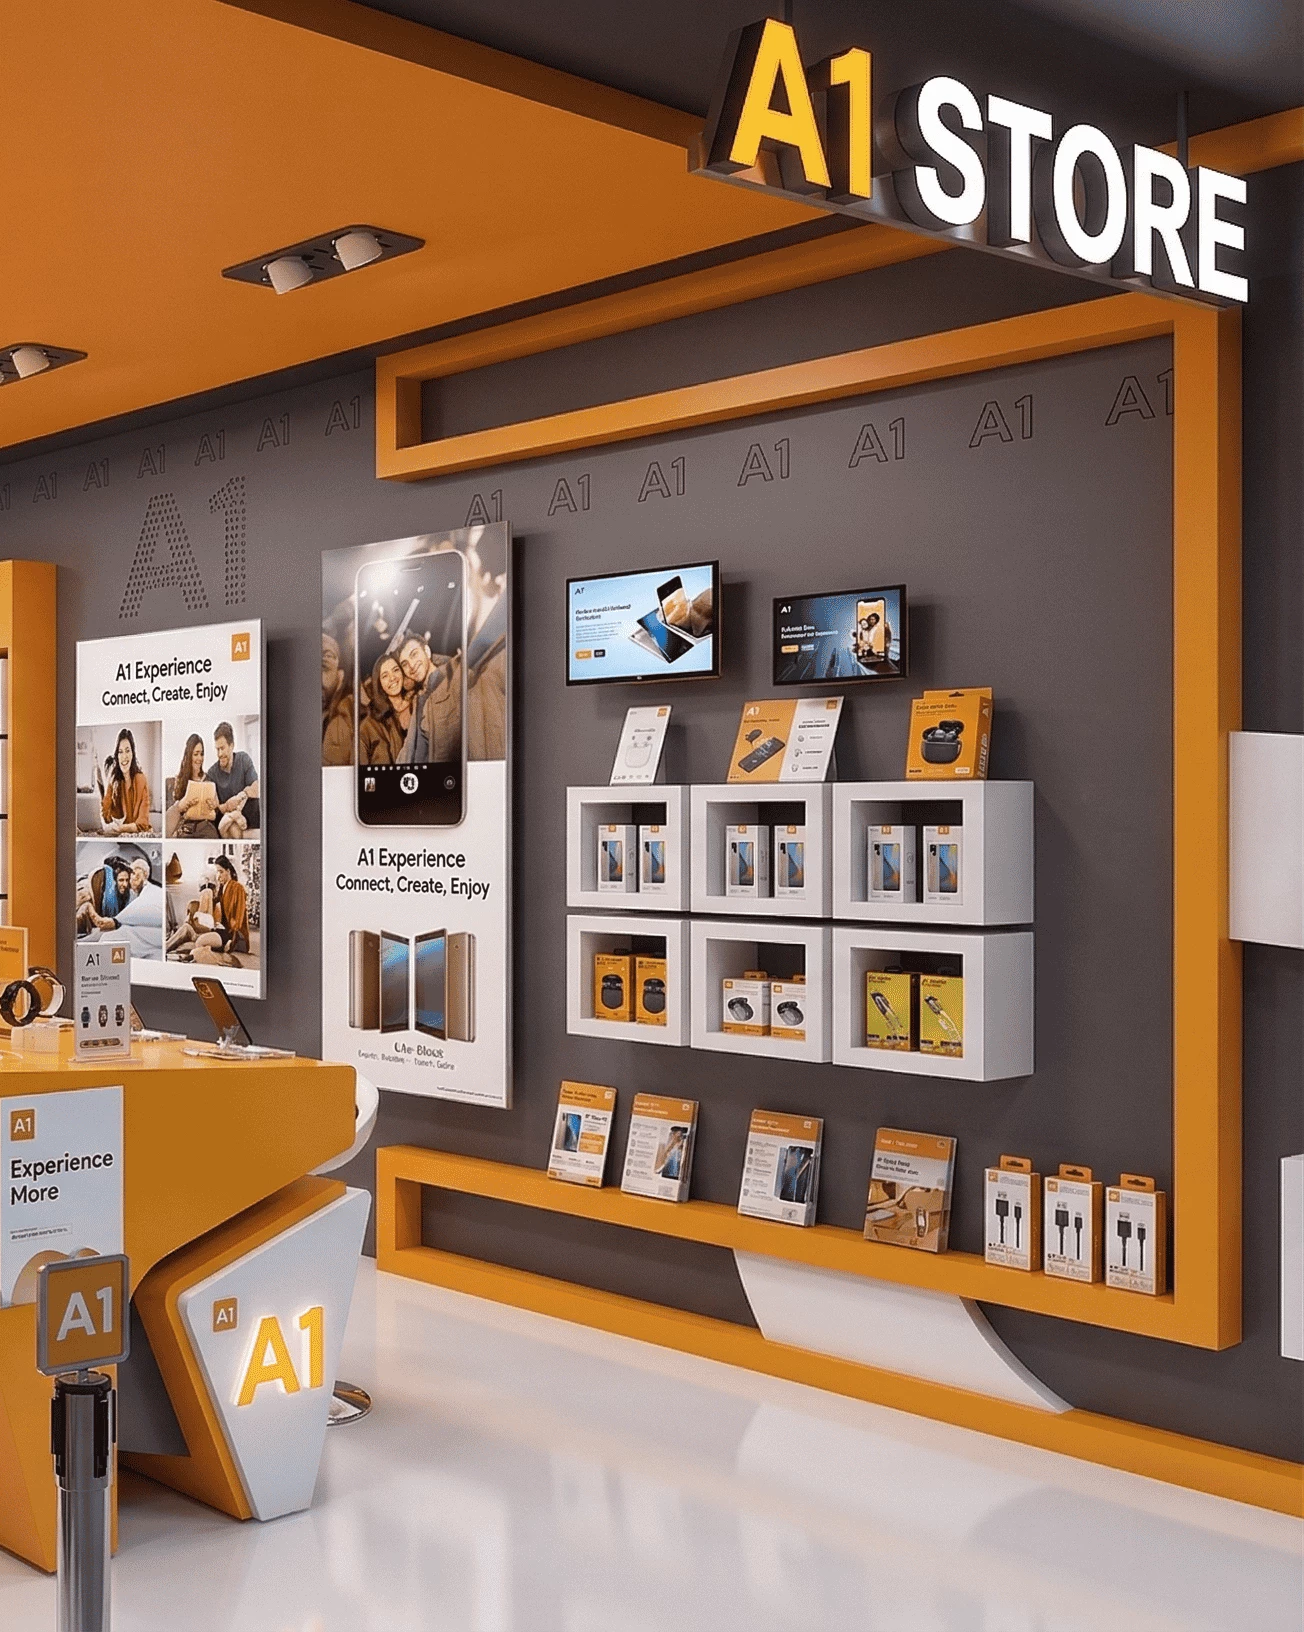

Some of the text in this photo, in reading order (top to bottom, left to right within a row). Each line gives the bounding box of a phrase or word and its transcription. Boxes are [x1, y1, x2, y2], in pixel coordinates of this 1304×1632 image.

[728, 18, 1249, 303] A1 STORE
[257, 413, 290, 451] A1
[326, 396, 361, 435] A1
[969, 395, 1034, 448] A1
[195, 430, 226, 465] A1
[849, 417, 905, 468] A1
[83, 459, 109, 492] A1
[137, 445, 166, 479] A1
[638, 456, 686, 503] A1
[737, 437, 791, 487] A1
[547, 473, 591, 516] A1
[118, 475, 246, 619] A1
[233, 640, 248, 653] A1
[116, 657, 212, 683] A1 Experience
[102, 682, 228, 706] Connect, Create, Enjoy
[357, 848, 466, 872] A1 Experience
[336, 874, 490, 900] Connect, Create, Enjoy
[13, 1117, 32, 1134] A1
[10, 1152, 114, 1182] Experience
[10, 1185, 59, 1206] More
[56, 1286, 113, 1341] A1
[216, 1307, 235, 1325] A1
[236, 1305, 325, 1408] A1
